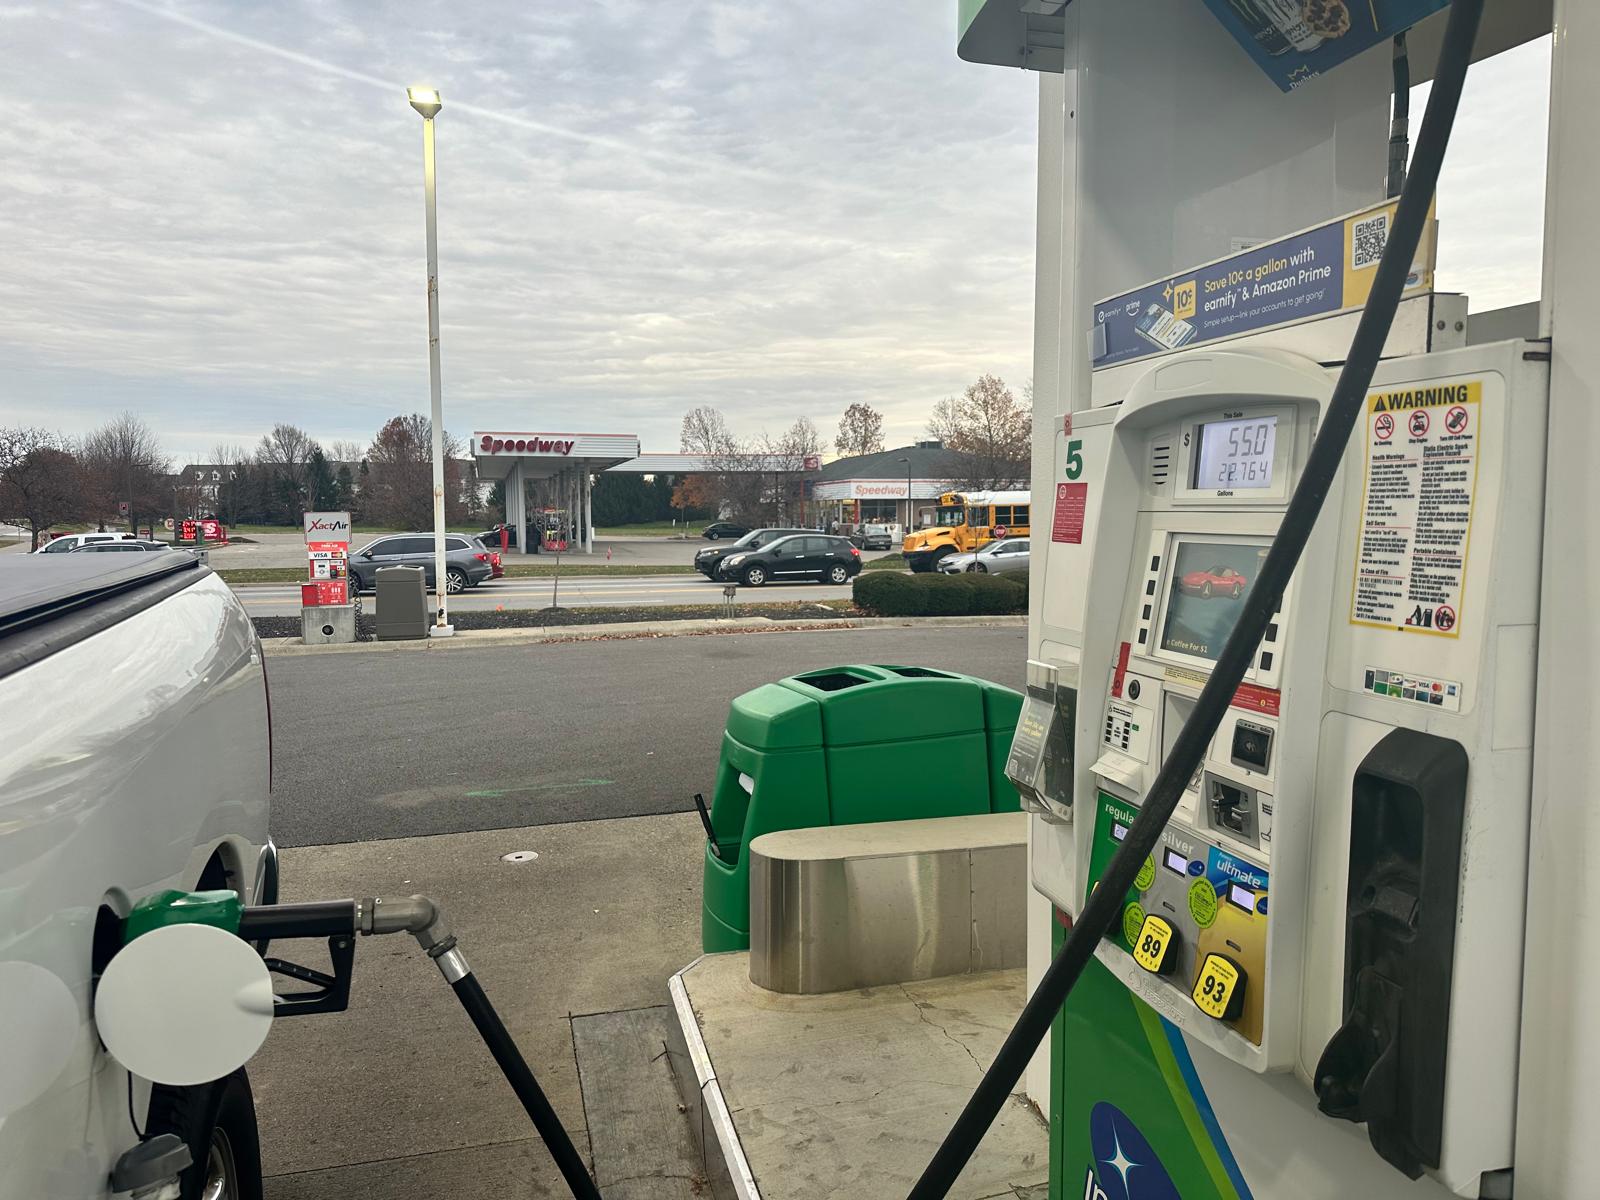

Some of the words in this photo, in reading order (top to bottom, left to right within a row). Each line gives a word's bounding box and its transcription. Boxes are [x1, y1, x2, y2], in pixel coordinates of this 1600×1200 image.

[1204, 278, 1227, 293] Save
[1228, 270, 1244, 285] 10¢
[1245, 269, 1253, 279] a
[1254, 258, 1287, 282] gallon
[1289, 245, 1315, 266] with
[1242, 286, 1250, 301] &
[1252, 276, 1296, 298] Amazon
[1298, 264, 1332, 285] Prime
[1125, 300, 1141, 312] prime
[1176, 288, 1193, 310] 10¢
[1203, 316, 1222, 328] Simple
[1249, 306, 1261, 318] your
[1261, 299, 1287, 314] accounts
[1287, 296, 1294, 307] to
[1294, 295, 1305, 308] get
[1388, 385, 1468, 410] WARNING
[1233, 411, 1243, 419] Sale
[480, 435, 574, 456] Speedway
[1183, 432, 1190, 448] $
[1228, 424, 1268, 458] 55.0
[1437, 444, 1454, 452] Electric
[1455, 443, 1468, 452] Spark
[1065, 439, 1083, 480] 5
[1218, 461, 1269, 482] 22.764
[855, 484, 908, 497] Speedway
[1216, 489, 1234, 498] Gallons
[308, 518, 348, 532] XactAir
[1413, 547, 1432, 555] Portable
[1170, 639, 1189, 650] Coffee
[1189, 642, 1200, 652] For
[1418, 681, 1430, 689] VISA
[1105, 804, 1136, 824] regula
[1161, 832, 1194, 855] silver
[1141, 934, 1161, 959] 89
[1202, 975, 1226, 1003] 93
